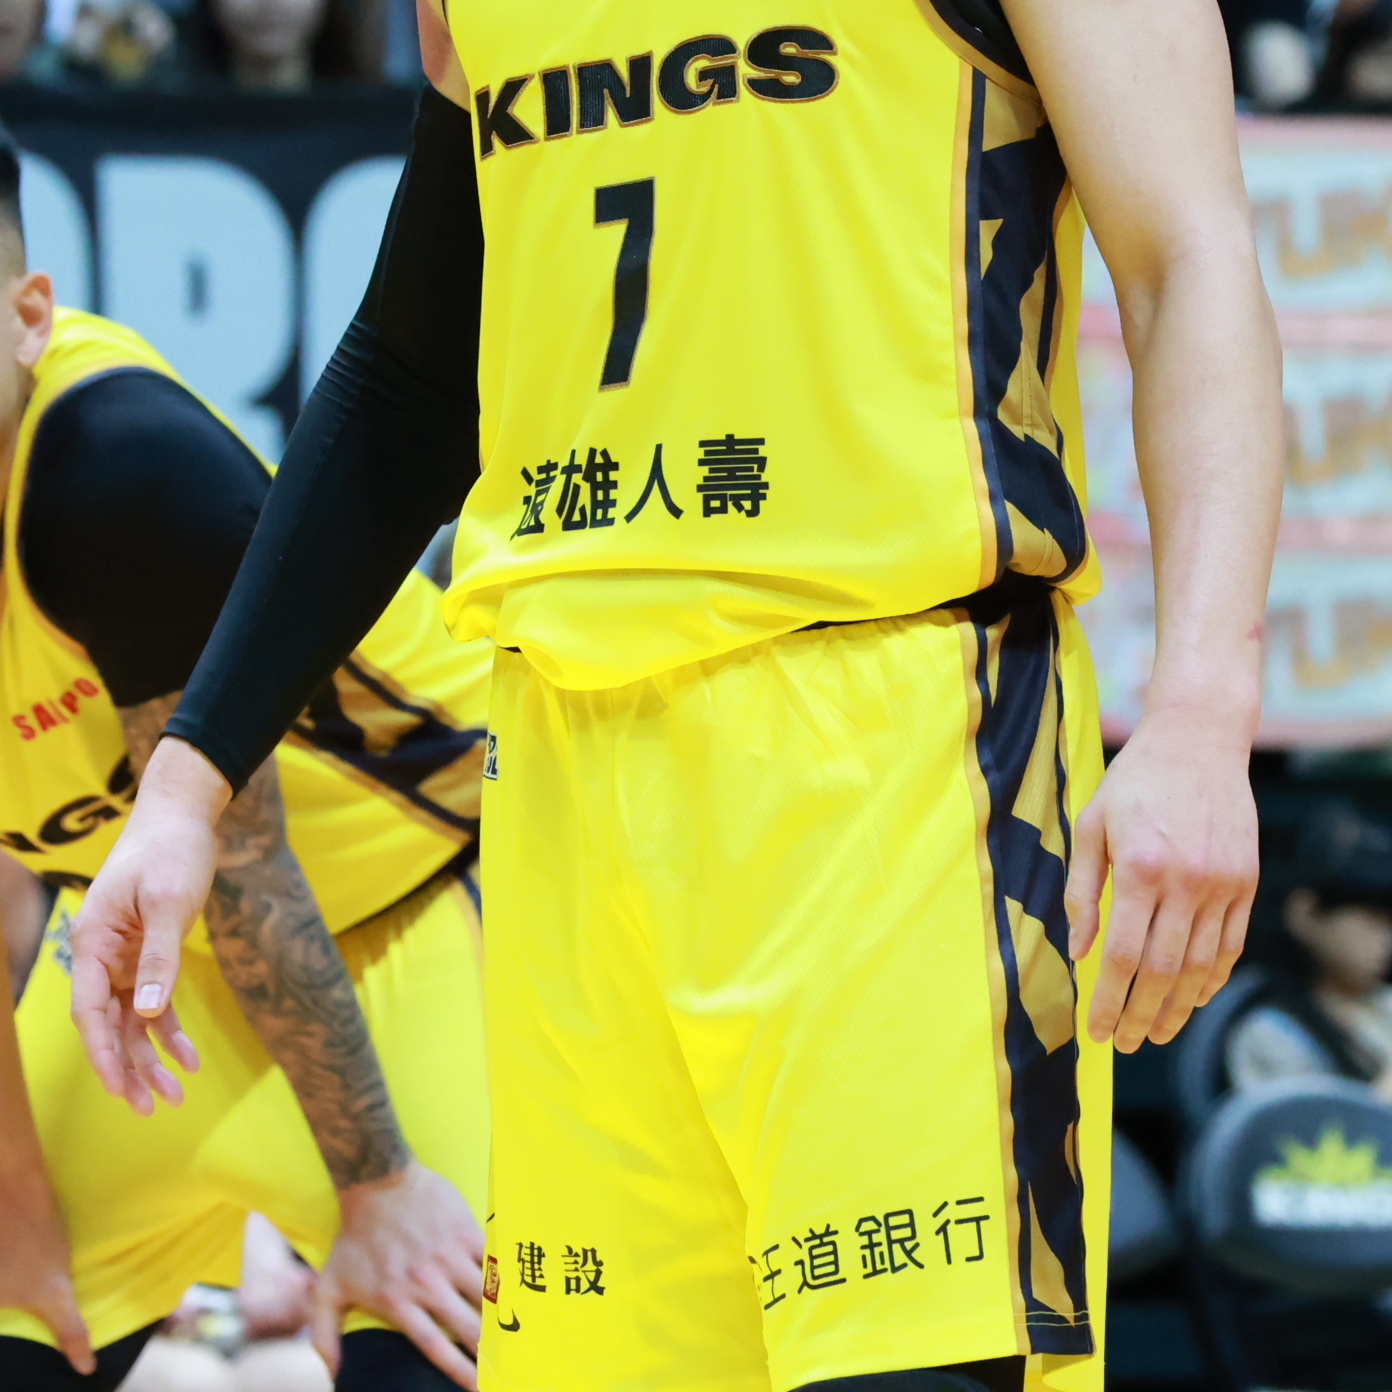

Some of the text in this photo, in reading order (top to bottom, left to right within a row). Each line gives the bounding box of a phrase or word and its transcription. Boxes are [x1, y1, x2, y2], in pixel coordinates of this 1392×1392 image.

[474, 24, 839, 162] KINGS
[593, 176, 655, 392] 7
[510, 433, 770, 542] 遠雄人壽
[515, 1240, 606, 1297] 建設
